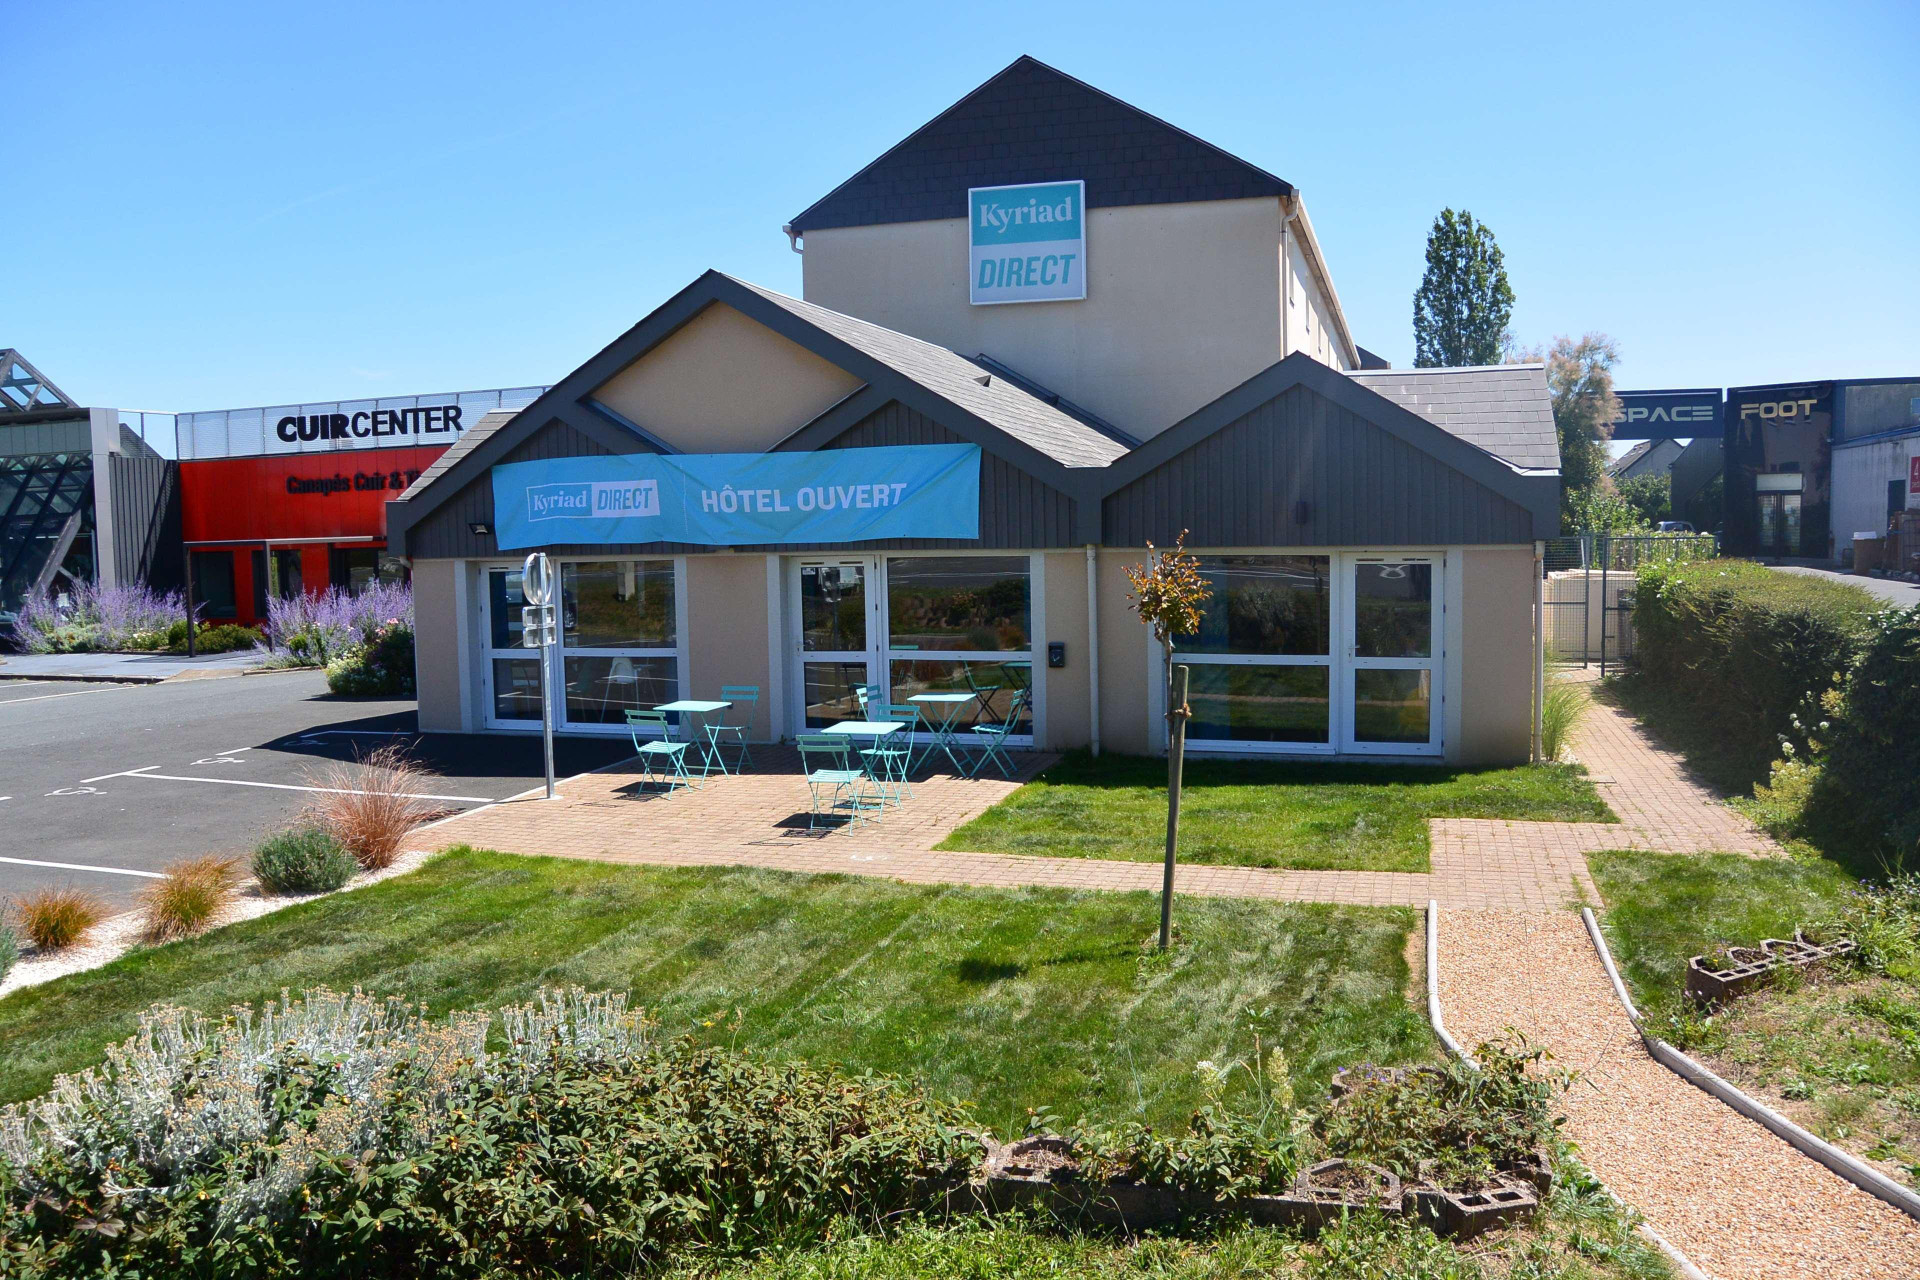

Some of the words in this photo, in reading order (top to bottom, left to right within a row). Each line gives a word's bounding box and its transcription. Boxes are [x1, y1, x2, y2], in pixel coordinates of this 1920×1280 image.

[979, 196, 1073, 234] Kyriad
[978, 253, 1077, 289] DIRECT
[1740, 399, 1818, 420] FOOT
[286, 473, 349, 496] Canapés
[353, 471, 387, 491] Cuir
[389, 470, 404, 490] &
[701, 484, 791, 514] HÔTEL
[796, 482, 908, 512] OUVERT
[533, 490, 588, 515] Kyriad
[597, 487, 653, 511] DIRECT
